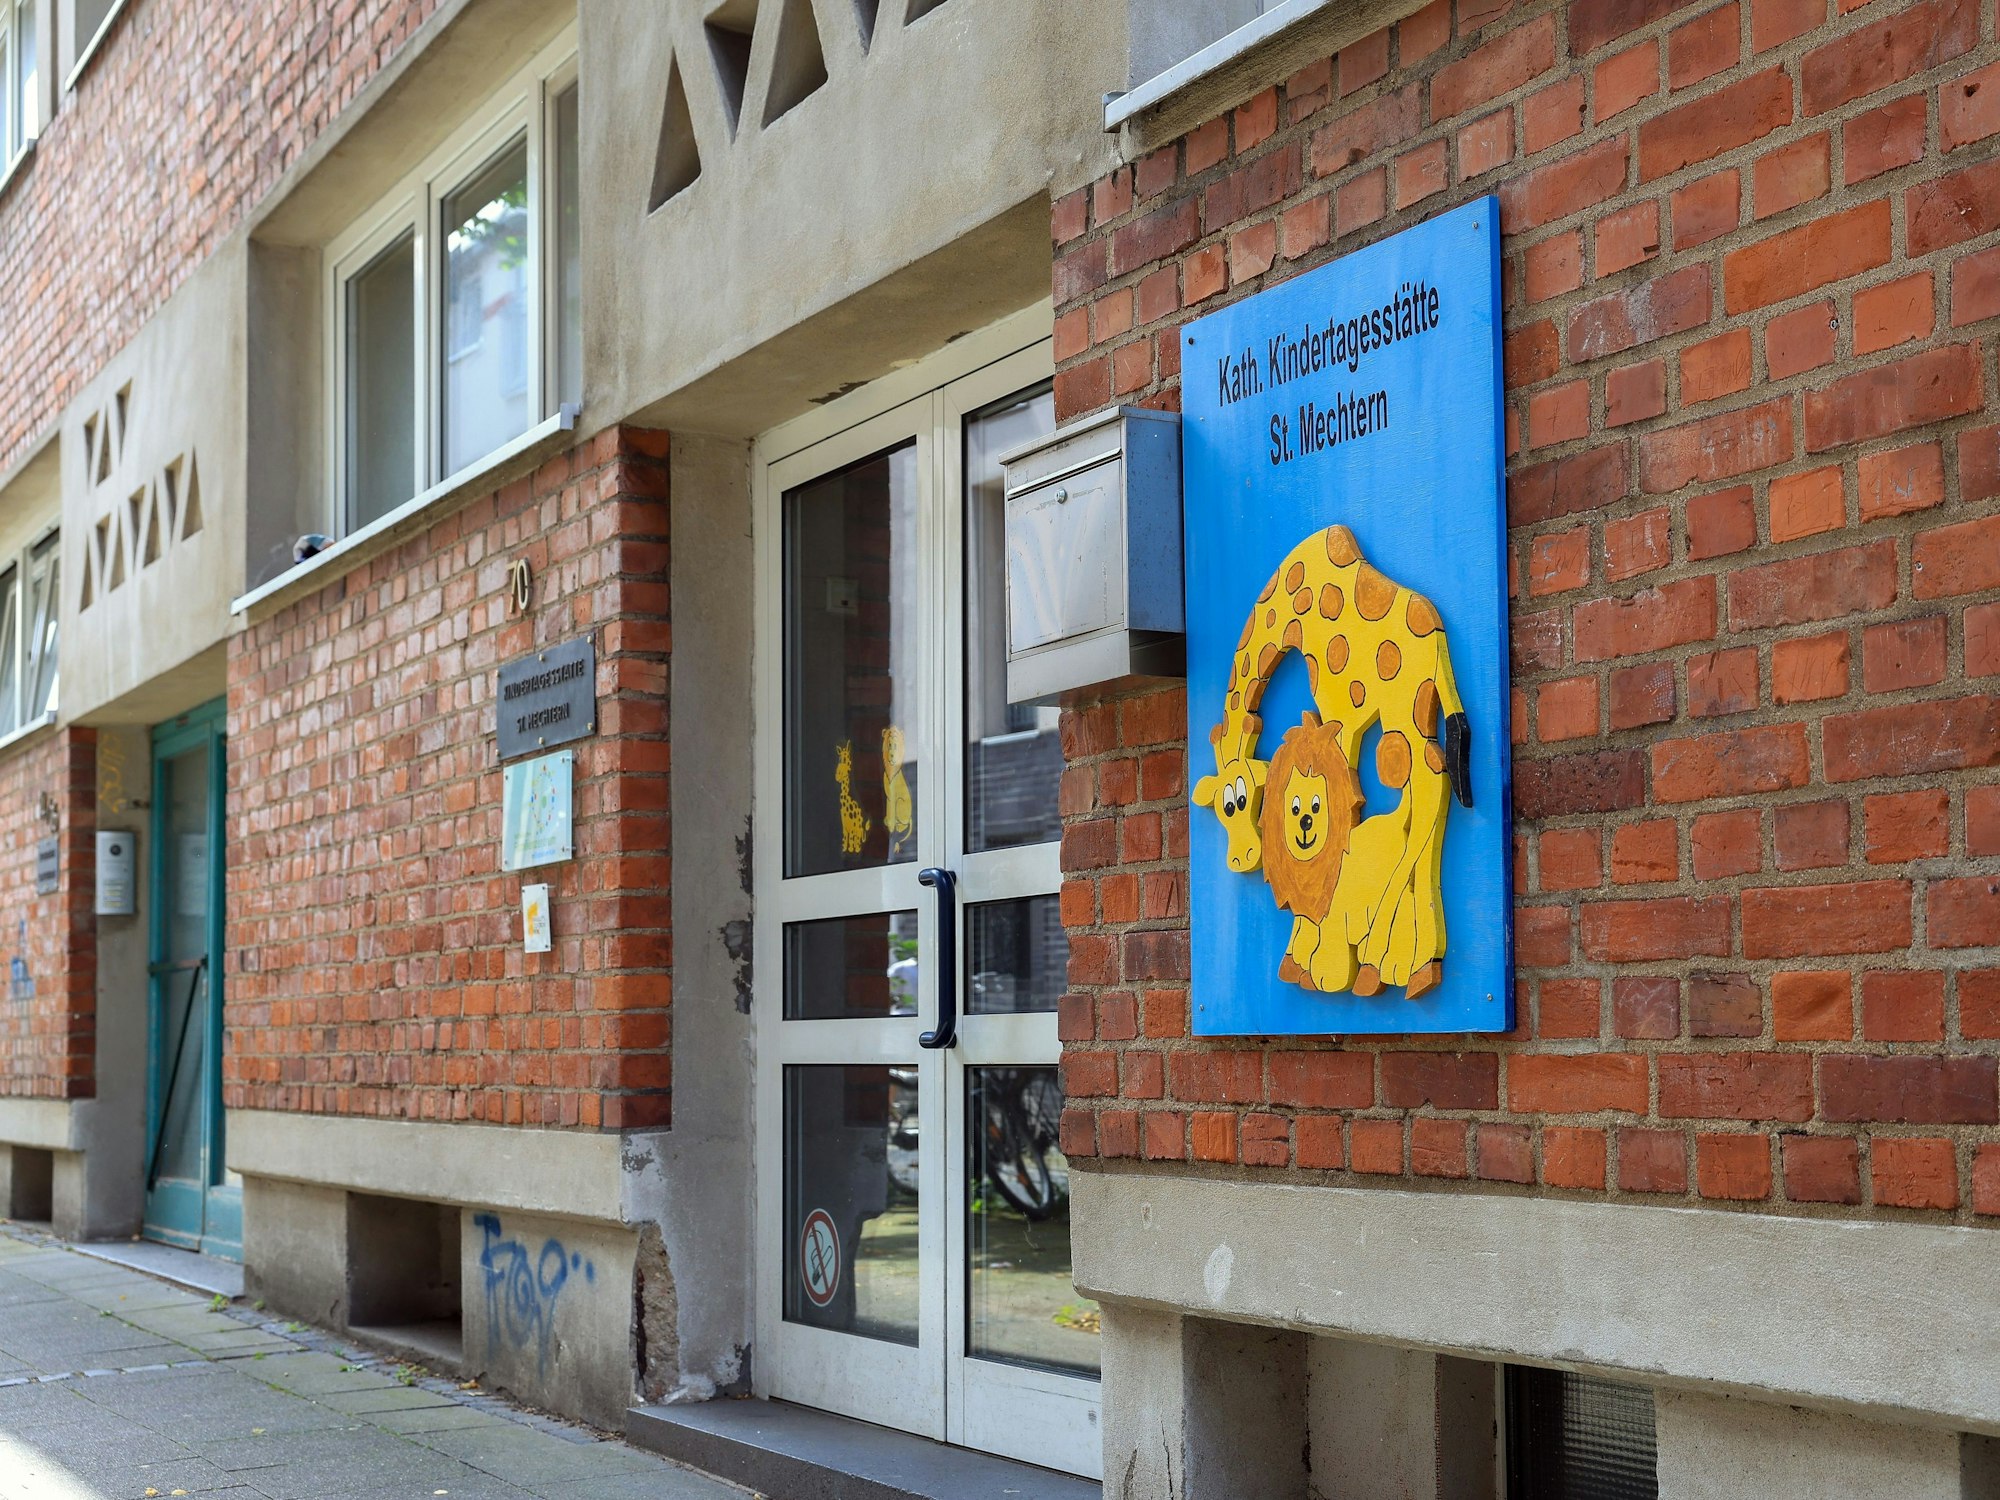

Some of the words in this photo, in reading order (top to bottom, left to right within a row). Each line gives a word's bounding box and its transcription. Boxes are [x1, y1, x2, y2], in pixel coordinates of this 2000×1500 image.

[1218, 347, 1263, 407] Kath.
[1268, 278, 1440, 389] Kindertagesstätte
[1270, 413, 1294, 466] St.
[1298, 389, 1389, 456] Mechtern
[507, 557, 531, 614] 70
